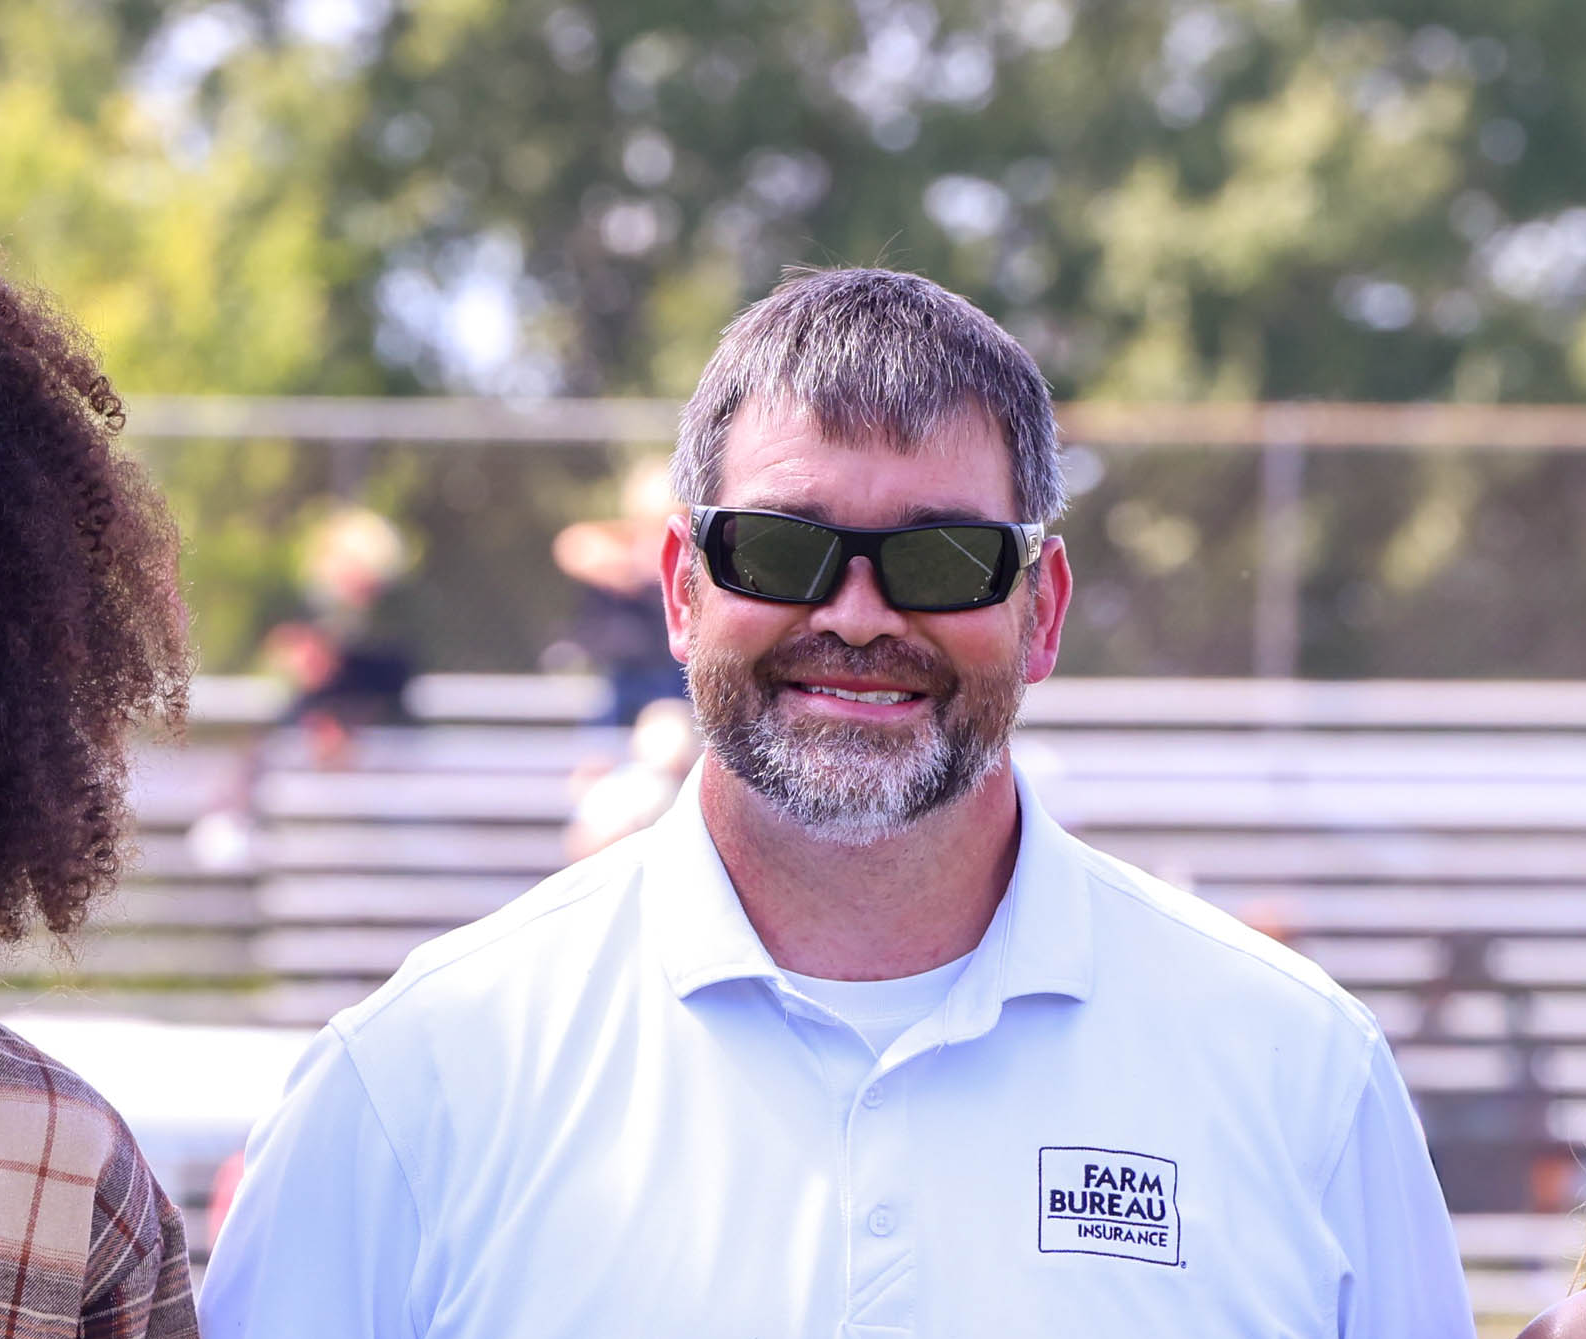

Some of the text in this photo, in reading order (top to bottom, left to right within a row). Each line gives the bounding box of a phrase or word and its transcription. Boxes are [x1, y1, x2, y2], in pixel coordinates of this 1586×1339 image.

[1084, 1164, 1163, 1196] FARM
[1050, 1189, 1166, 1221] BUREAU
[1078, 1224, 1168, 1247] INSURANCE
